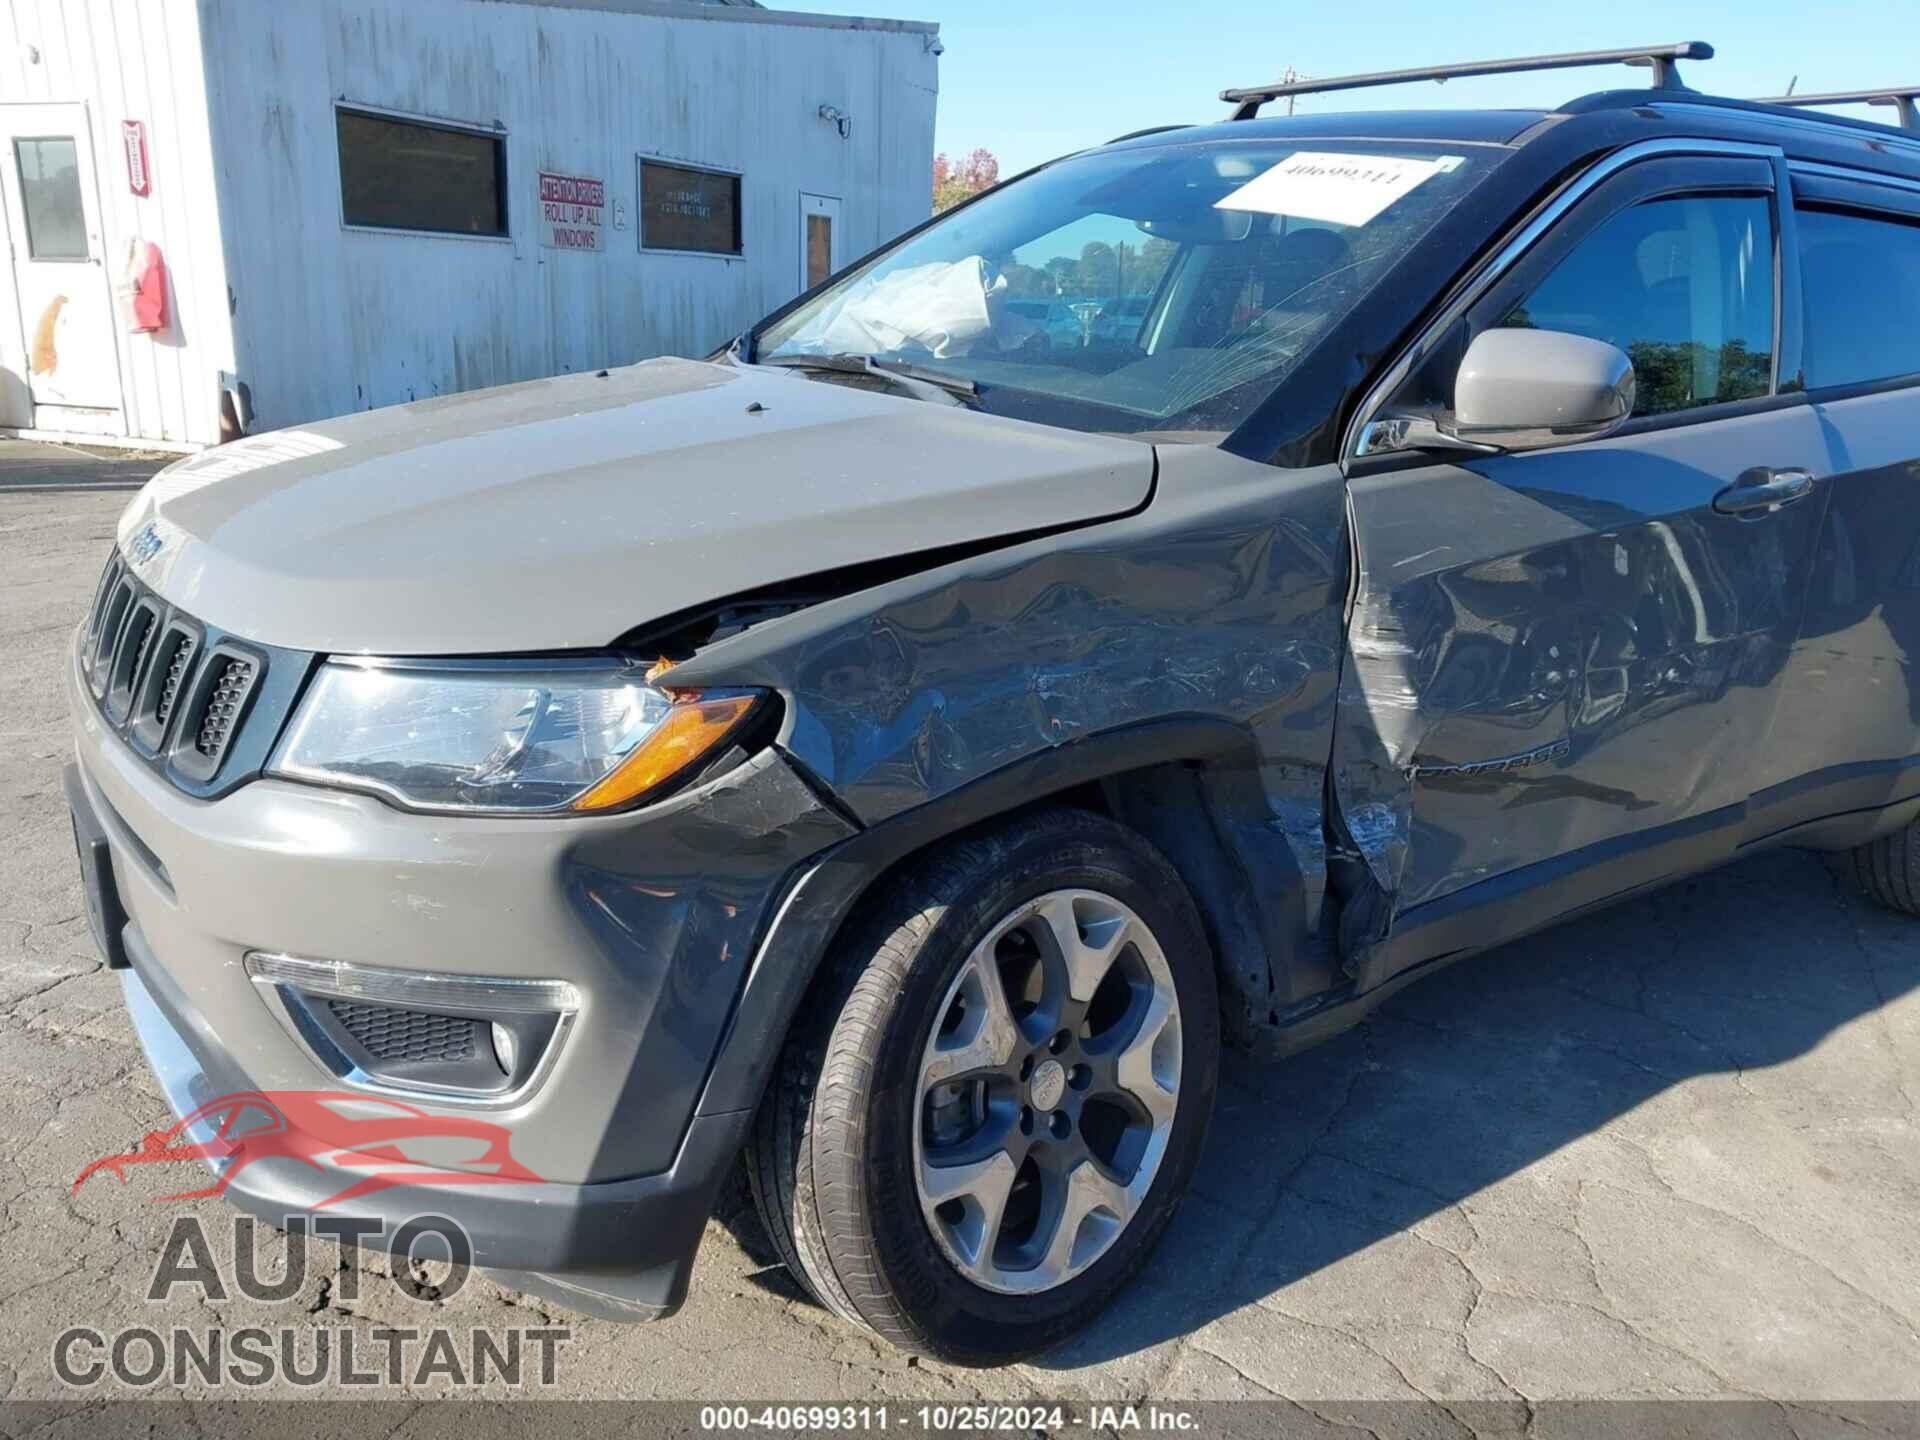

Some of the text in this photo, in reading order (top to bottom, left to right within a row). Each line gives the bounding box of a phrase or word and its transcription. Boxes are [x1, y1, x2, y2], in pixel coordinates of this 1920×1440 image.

[541, 177, 577, 202] ATTENTION
[544, 203, 602, 226] ROLL UP ALL
[552, 227, 595, 249] WINDOWS
